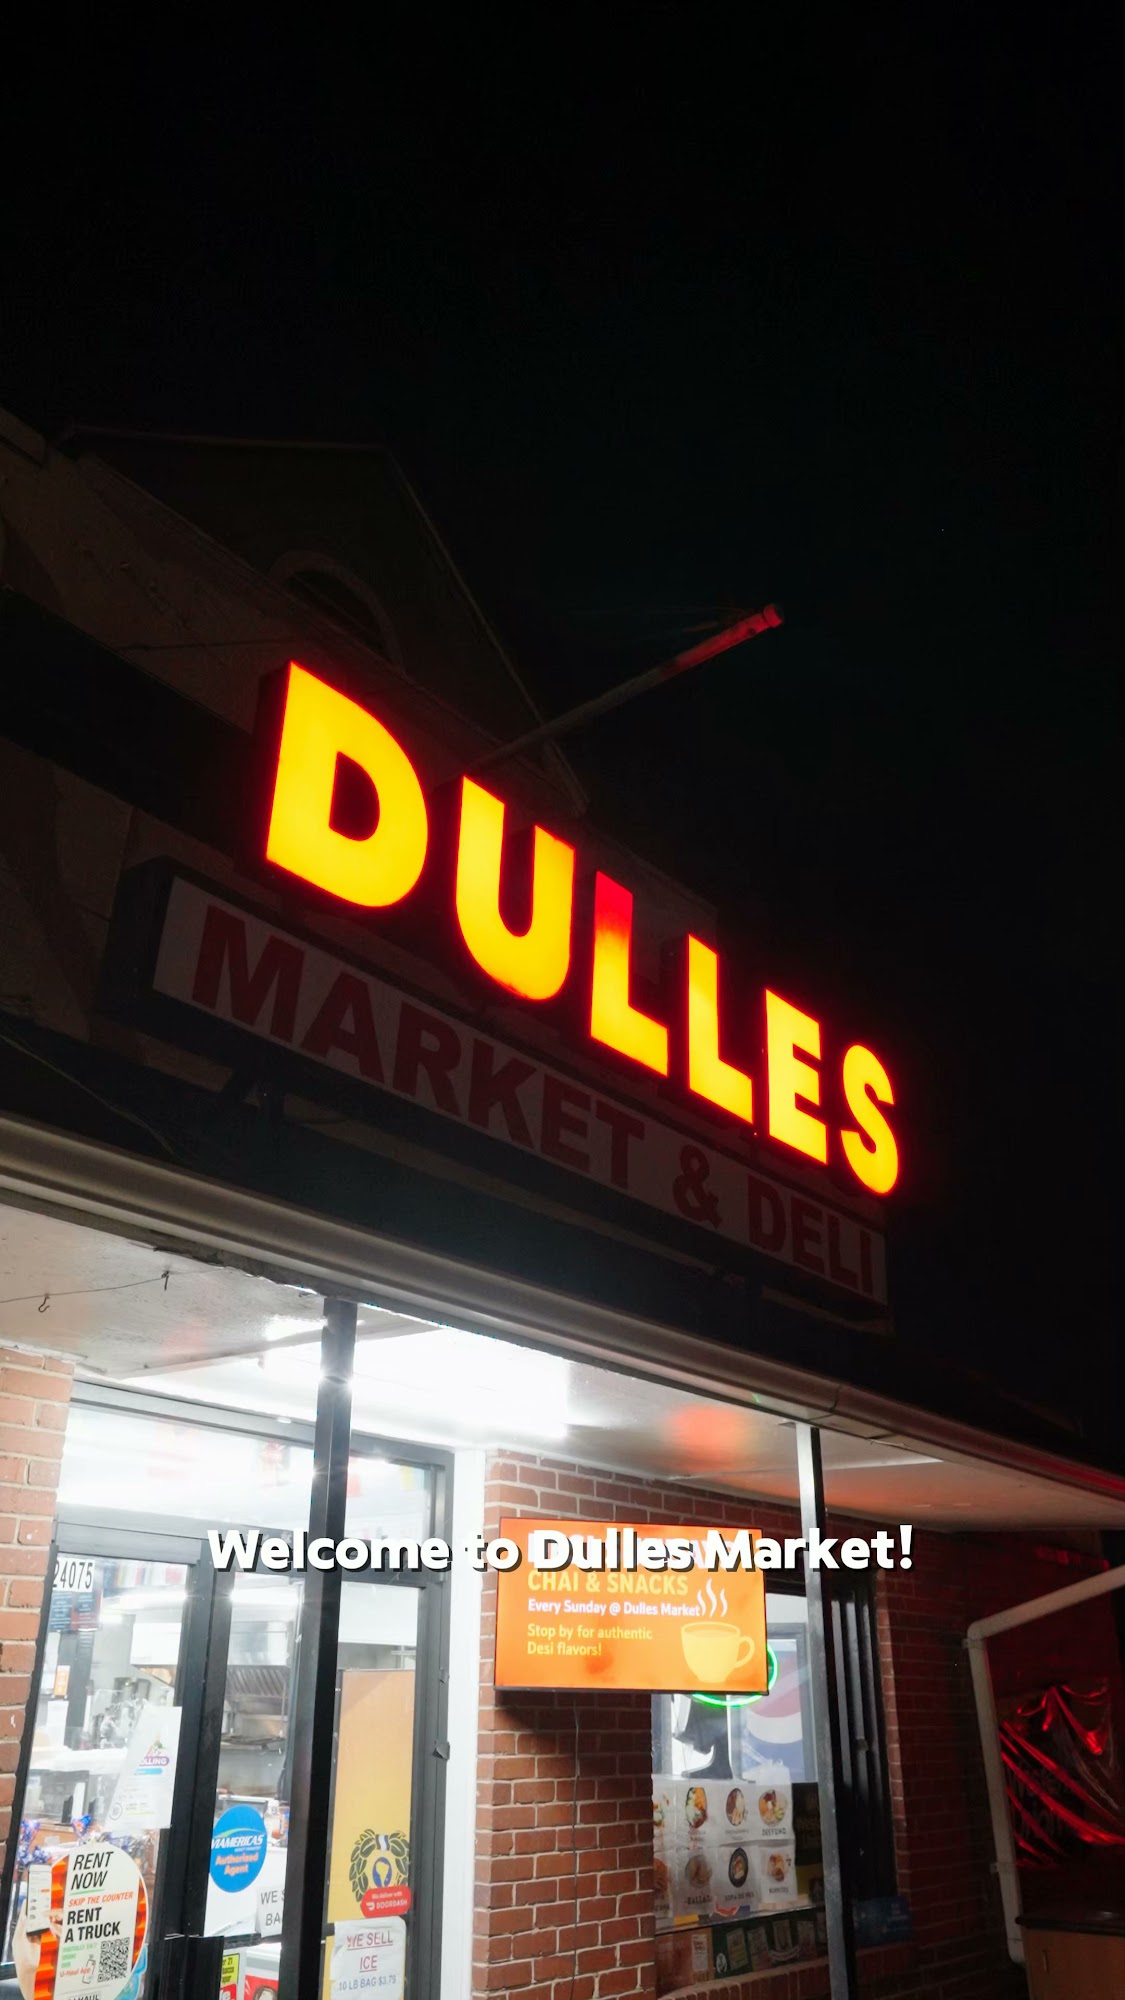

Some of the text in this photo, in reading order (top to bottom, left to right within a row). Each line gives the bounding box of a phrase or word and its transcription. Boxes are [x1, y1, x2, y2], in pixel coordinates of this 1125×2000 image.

[265, 660, 900, 1195] DULLES
[194, 904, 873, 1294] MARKET & DELI
[53, 1560, 93, 1589] 24075
[527, 1570, 689, 1596] CHAI & SNACKS
[528, 1599, 700, 1617] Every Sunday @ Dulles Market
[527, 1624, 653, 1641] Stop by for authentic
[527, 1641, 602, 1656] Desi flavors!
[73, 1851, 114, 1871] RENT
[215, 1852, 259, 1866] Authorized
[224, 1864, 249, 1877] Agent
[71, 1871, 108, 1890] NOW
[68, 1891, 134, 1907] SKIP THE COUNTER
[260, 1890, 278, 1905] WE
[67, 1907, 102, 1925] RENT
[65, 1921, 121, 1944] A TRUCK
[347, 1930, 394, 1948] WE SELL
[360, 1955, 378, 1970] ICE
[339, 1981, 347, 1991] 10
[349, 1979, 359, 1990] LB
[360, 1977, 377, 1988] BAG
